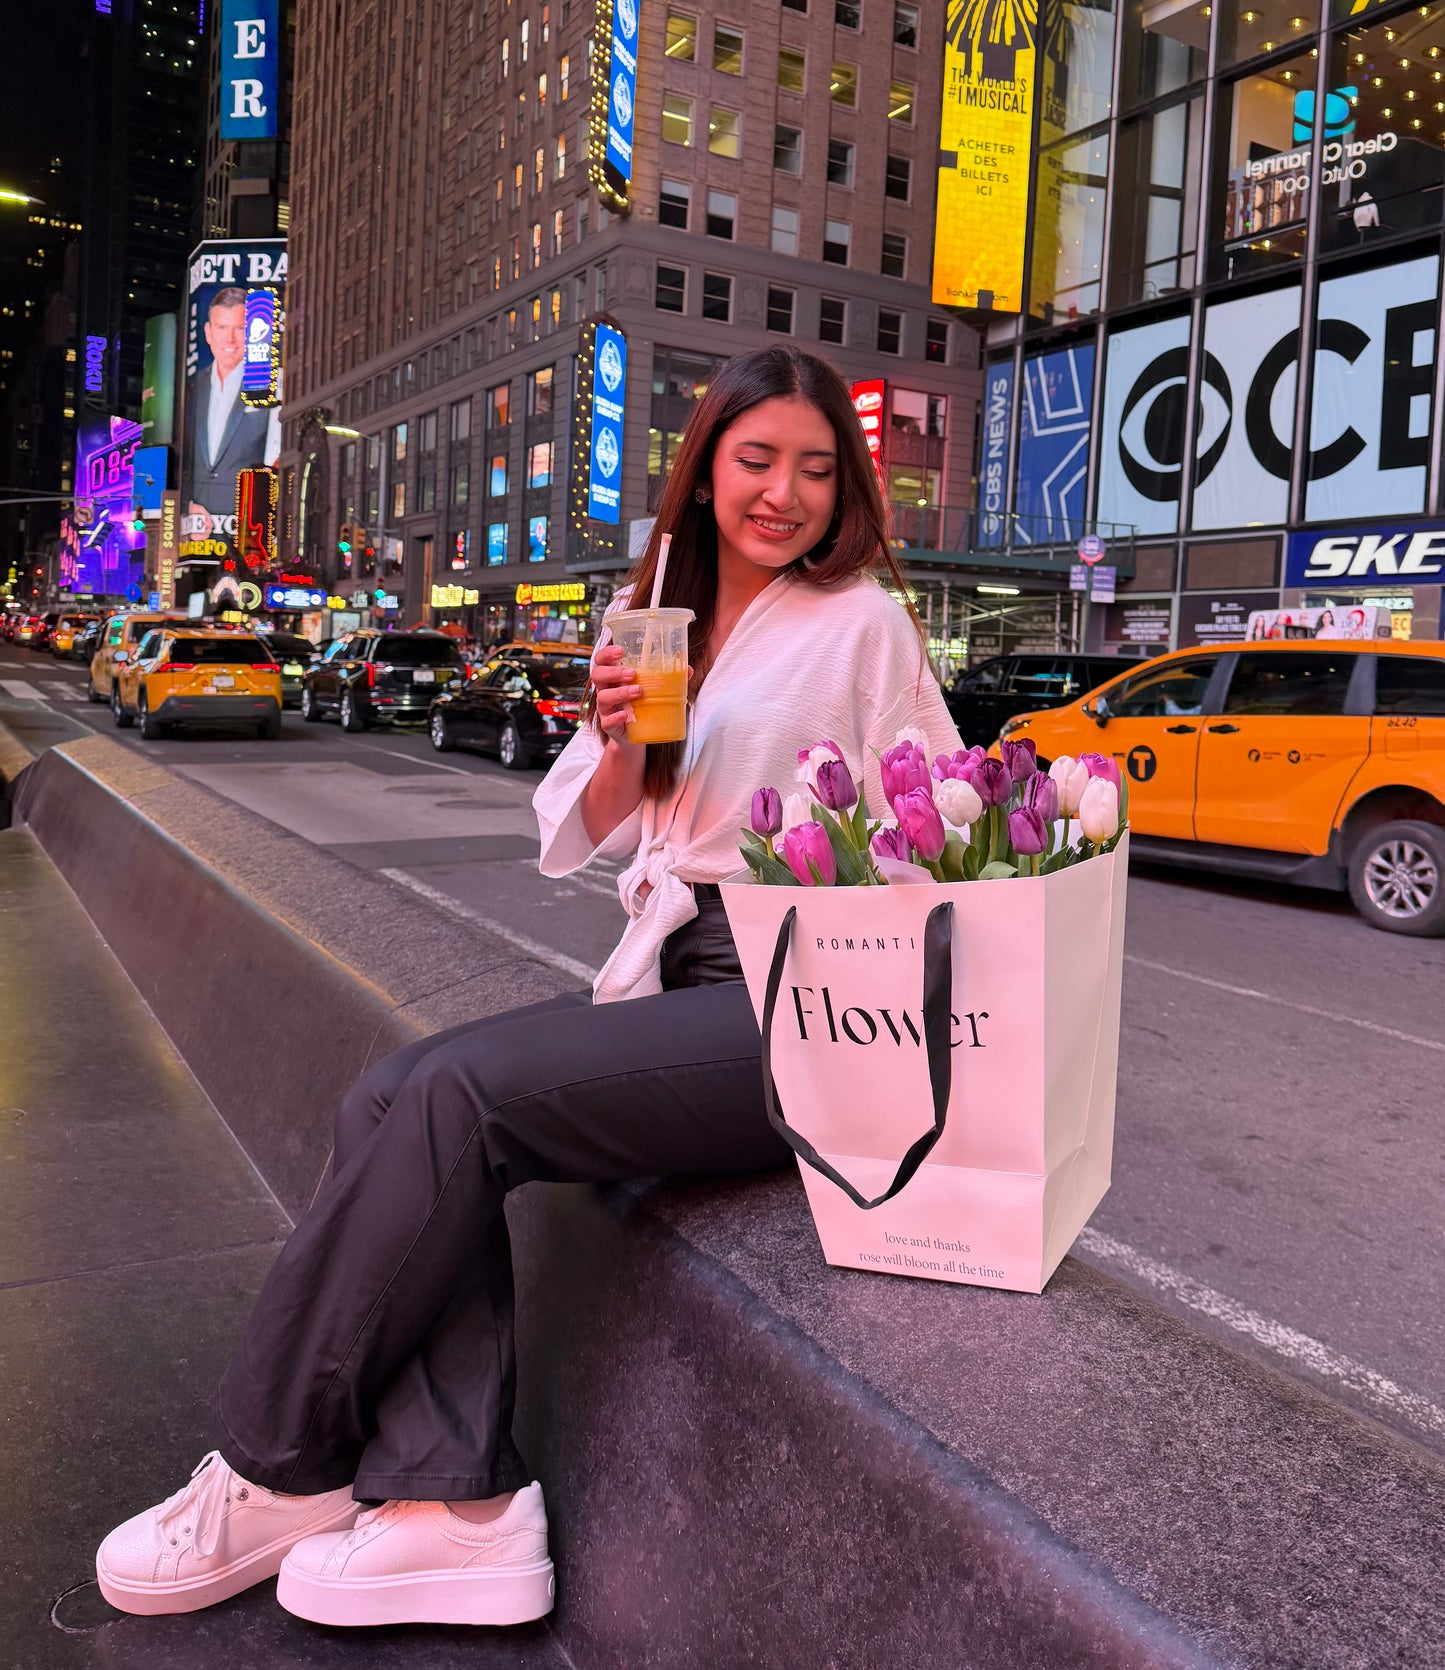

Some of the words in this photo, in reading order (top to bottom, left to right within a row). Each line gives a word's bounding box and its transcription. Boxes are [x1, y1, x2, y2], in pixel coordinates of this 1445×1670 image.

[966, 87, 1027, 114] MUSICAL
[958, 138, 1015, 155] ACHETER
[974, 155, 998, 167] DES
[960, 168, 1010, 183] BILLETS
[976, 186, 993, 196] ICI
[988, 377, 1007, 459] NEWS
[985, 461, 1003, 517] CBS
[162, 498, 175, 549] SQUARE
[162, 558, 173, 596] TIMES
[816, 937, 915, 950] ROMANTI
[884, 1231, 908, 1245] love
[910, 1237, 931, 1248] and
[933, 1239, 971, 1253] thanks
[859, 1253, 881, 1263] rose
[883, 1253, 903, 1266] will
[904, 1256, 941, 1271] bloom
[943, 1261, 956, 1273] all
[958, 1263, 977, 1275] the
[979, 1265, 1005, 1279] time
